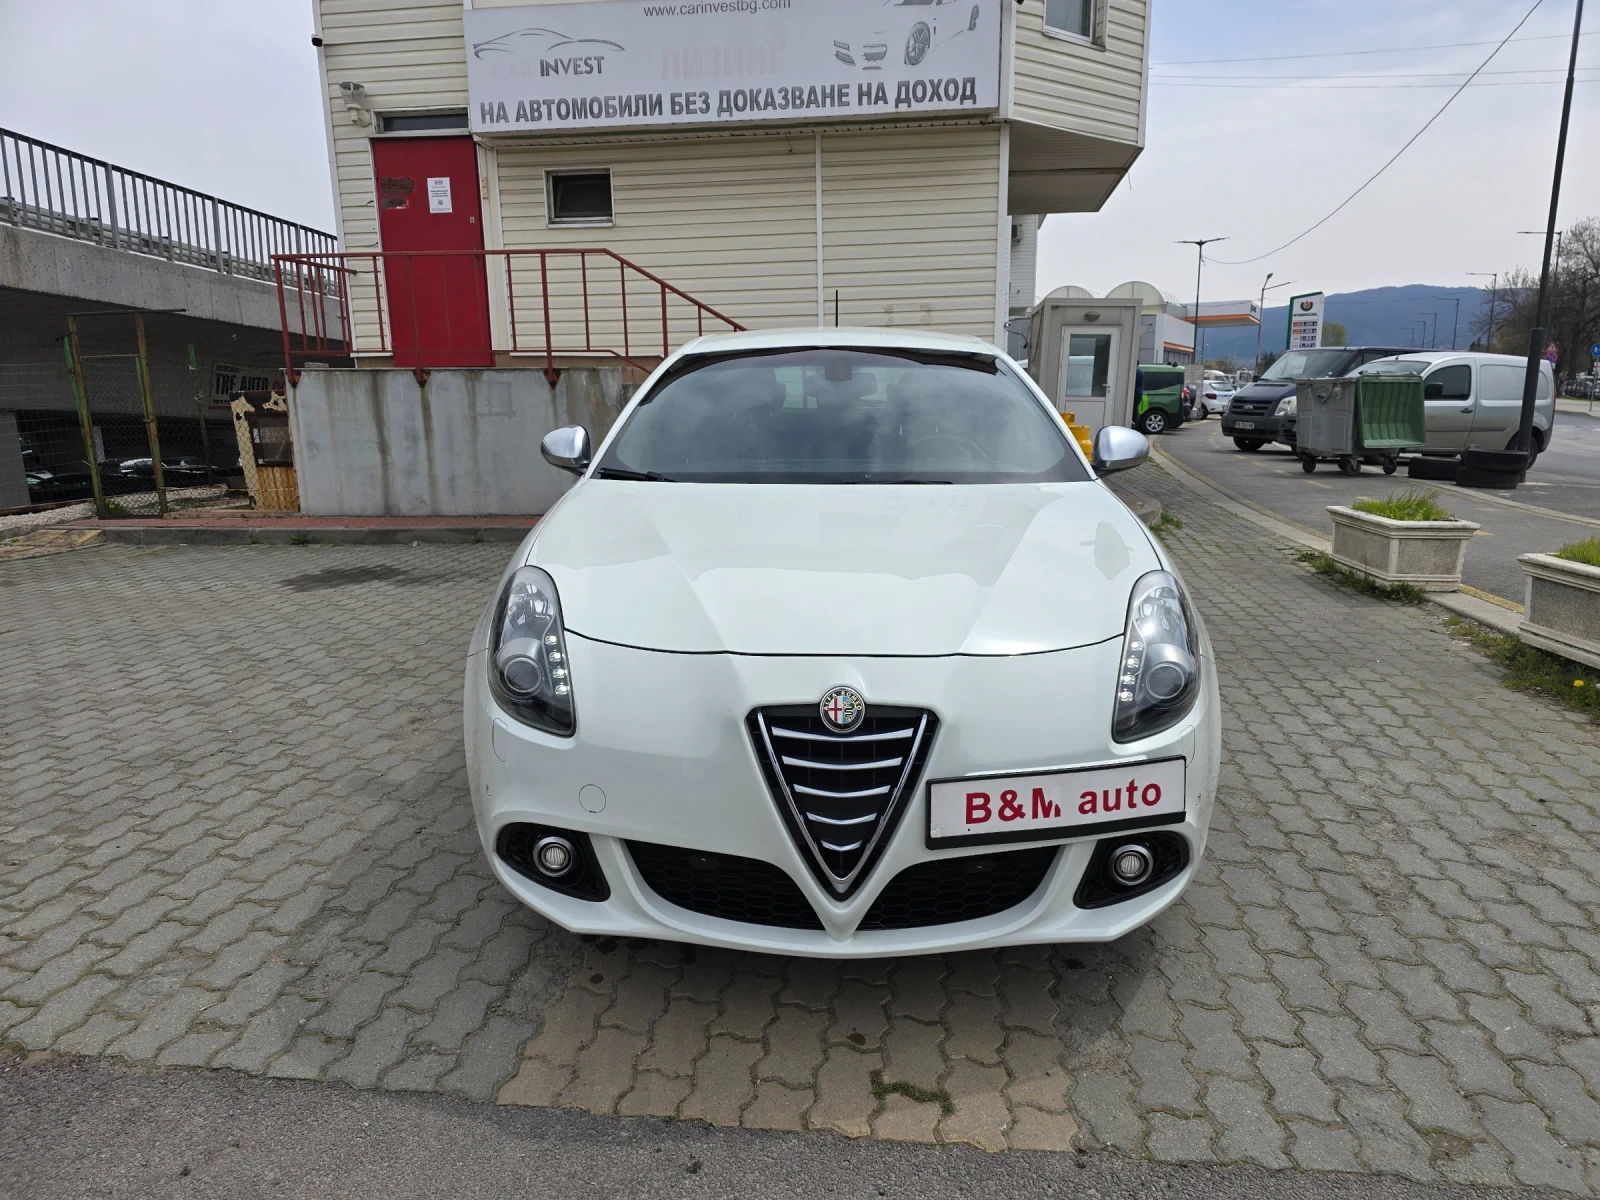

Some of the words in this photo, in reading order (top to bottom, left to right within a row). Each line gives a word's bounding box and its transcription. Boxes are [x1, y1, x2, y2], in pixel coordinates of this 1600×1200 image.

[643, 0, 791, 17] www.carinvestbg.com
[539, 56, 605, 77] INVEST
[480, 101, 510, 124] НА
[515, 93, 663, 123] АВТОМОБИЛИ
[670, 91, 711, 115] БЕЗ
[717, 84, 850, 118] ДОКАЗВАНЕ
[858, 82, 889, 106] НА
[895, 77, 977, 109] ДОХОД
[1078, 778, 1162, 815] auto
